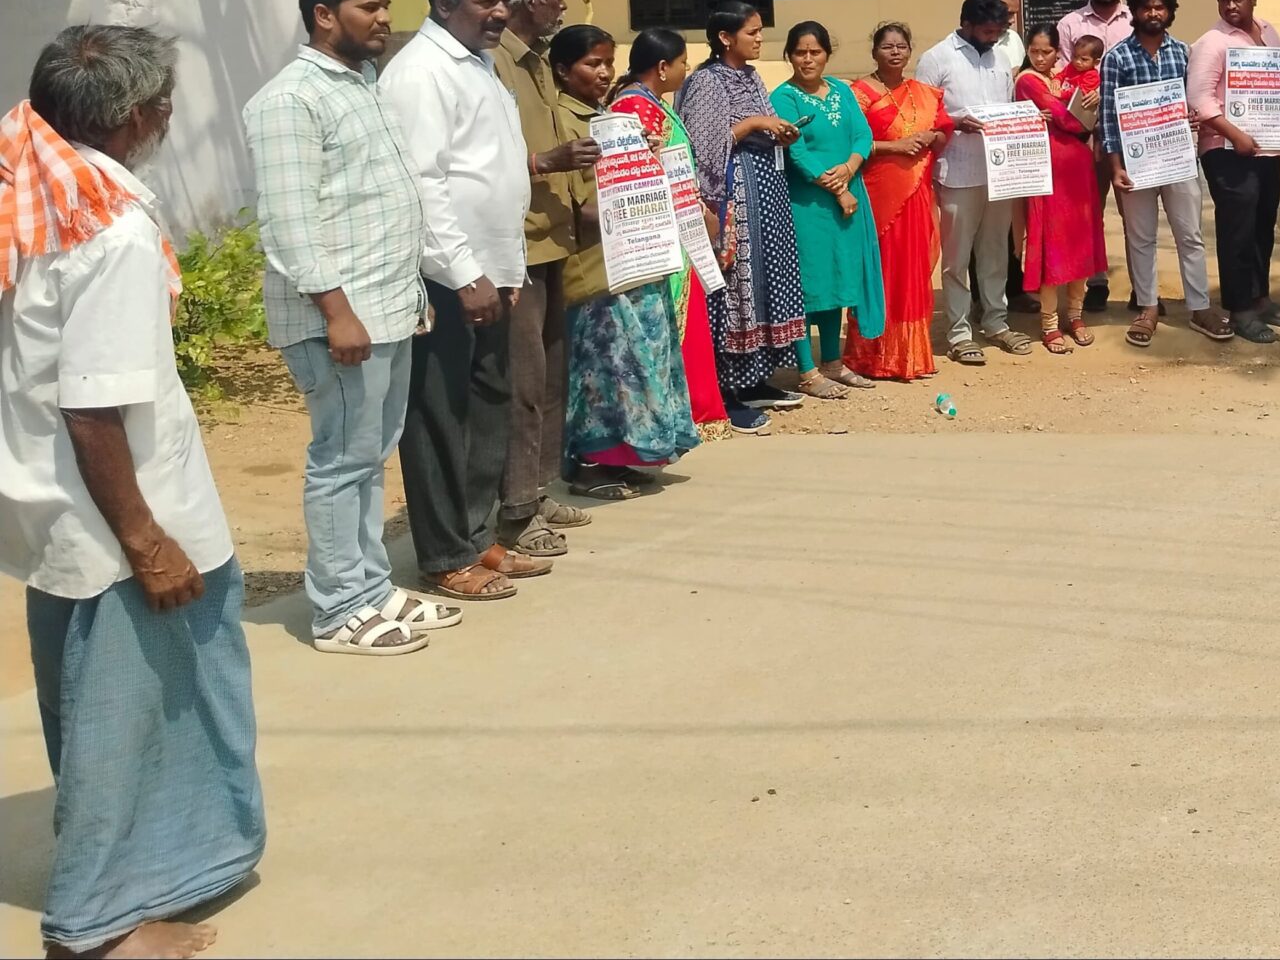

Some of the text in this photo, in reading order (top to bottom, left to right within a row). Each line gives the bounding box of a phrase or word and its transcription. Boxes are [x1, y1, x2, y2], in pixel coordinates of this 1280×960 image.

[1161, 128, 1187, 139] MARRIAGE
[1022, 141, 1047, 149] MARRIAGE
[1146, 135, 1188, 150] FREE BHARAT
[1023, 148, 1047, 156] BHARAT
[634, 179, 663, 189] CAMPAIGN
[627, 190, 667, 206] MARRIAGE
[630, 201, 668, 217] BHARAT
[627, 234, 660, 244] Telangana
